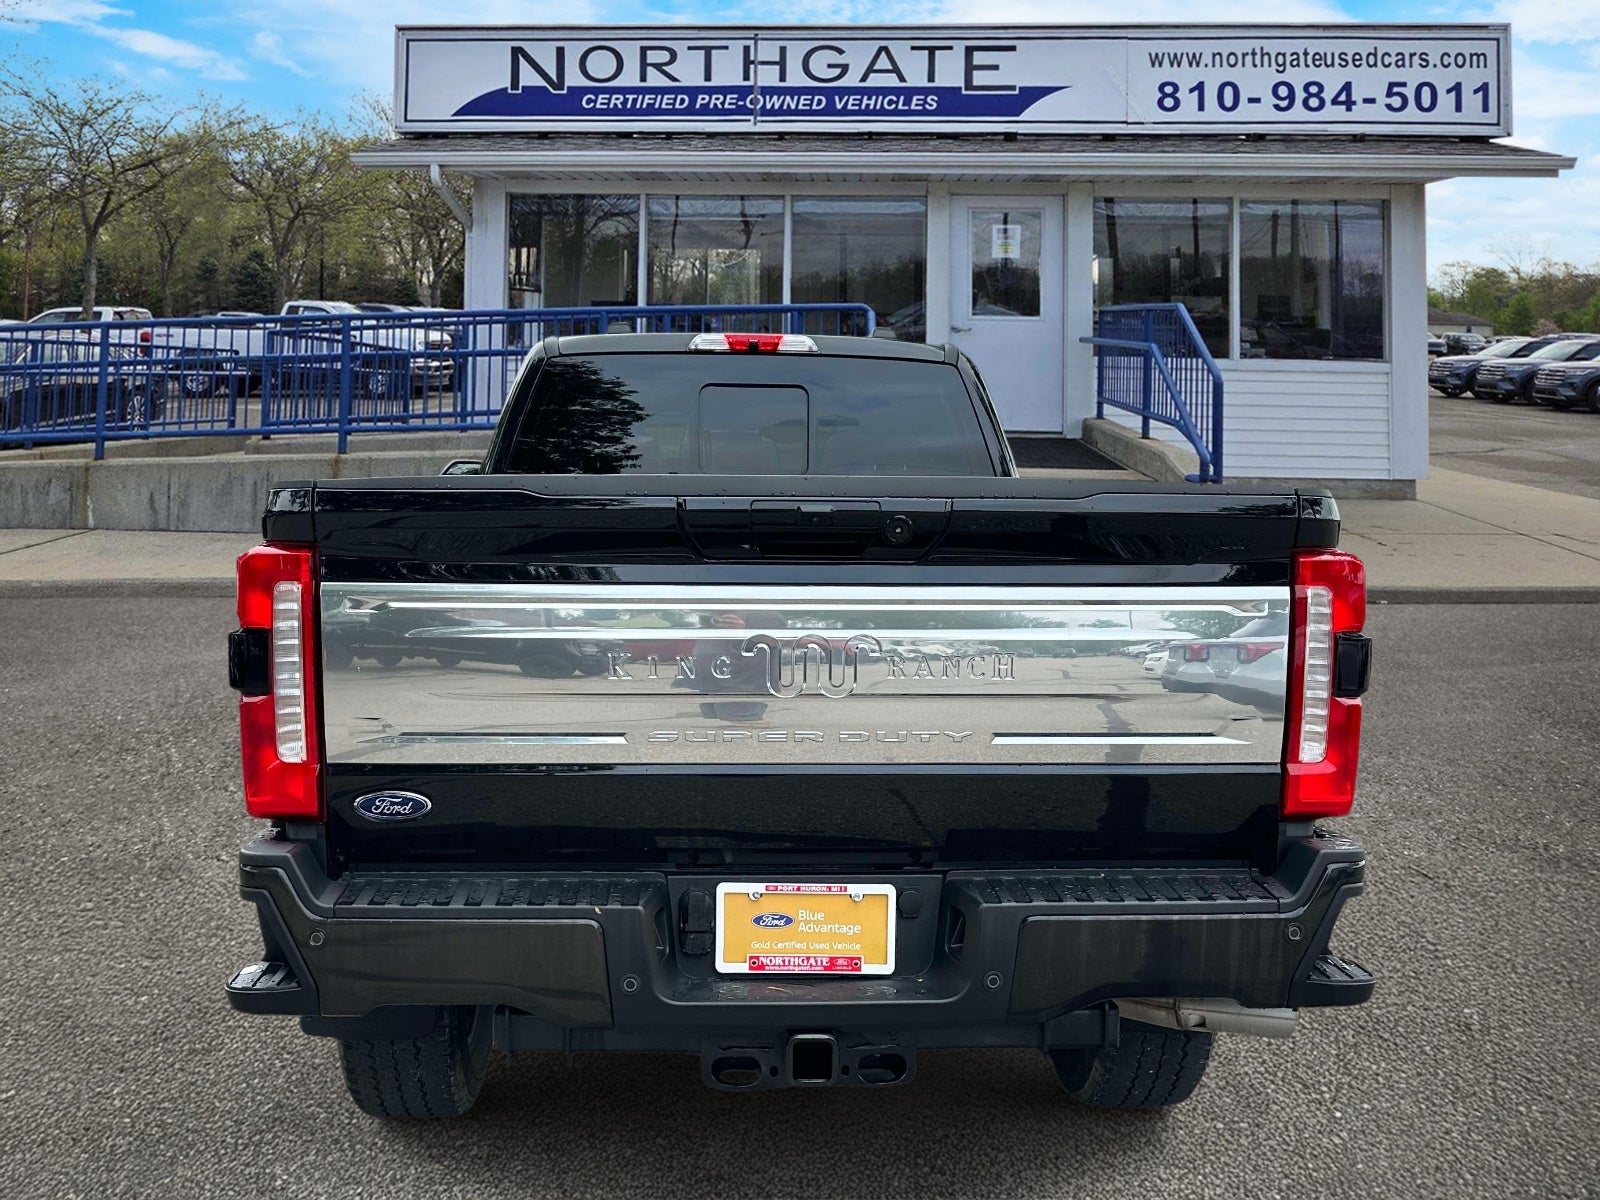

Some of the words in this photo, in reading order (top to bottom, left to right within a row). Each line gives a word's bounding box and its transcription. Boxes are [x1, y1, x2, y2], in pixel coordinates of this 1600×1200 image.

[510, 45, 1018, 92] NORTHGATE
[1148, 46, 1488, 74] www.northgateusedcars.com
[581, 93, 690, 110] CERTIFIED
[695, 93, 828, 111] PRE-OWNED
[834, 94, 939, 111] VEHICLES
[1156, 80, 1492, 114] 810-984-5011
[607, 649, 732, 681] KING
[886, 652, 1016, 681] RANCH
[647, 731, 825, 743] SUPER
[839, 731, 973, 743] DUTY
[371, 797, 413, 814] Ford
[798, 910, 825, 921] Blue
[798, 922, 862, 935] Advantage
[751, 941, 770, 949] Gold
[772, 941, 807, 949] Certified
[832, 942, 862, 950] Vehicle
[759, 956, 831, 966] NORTHGATE
